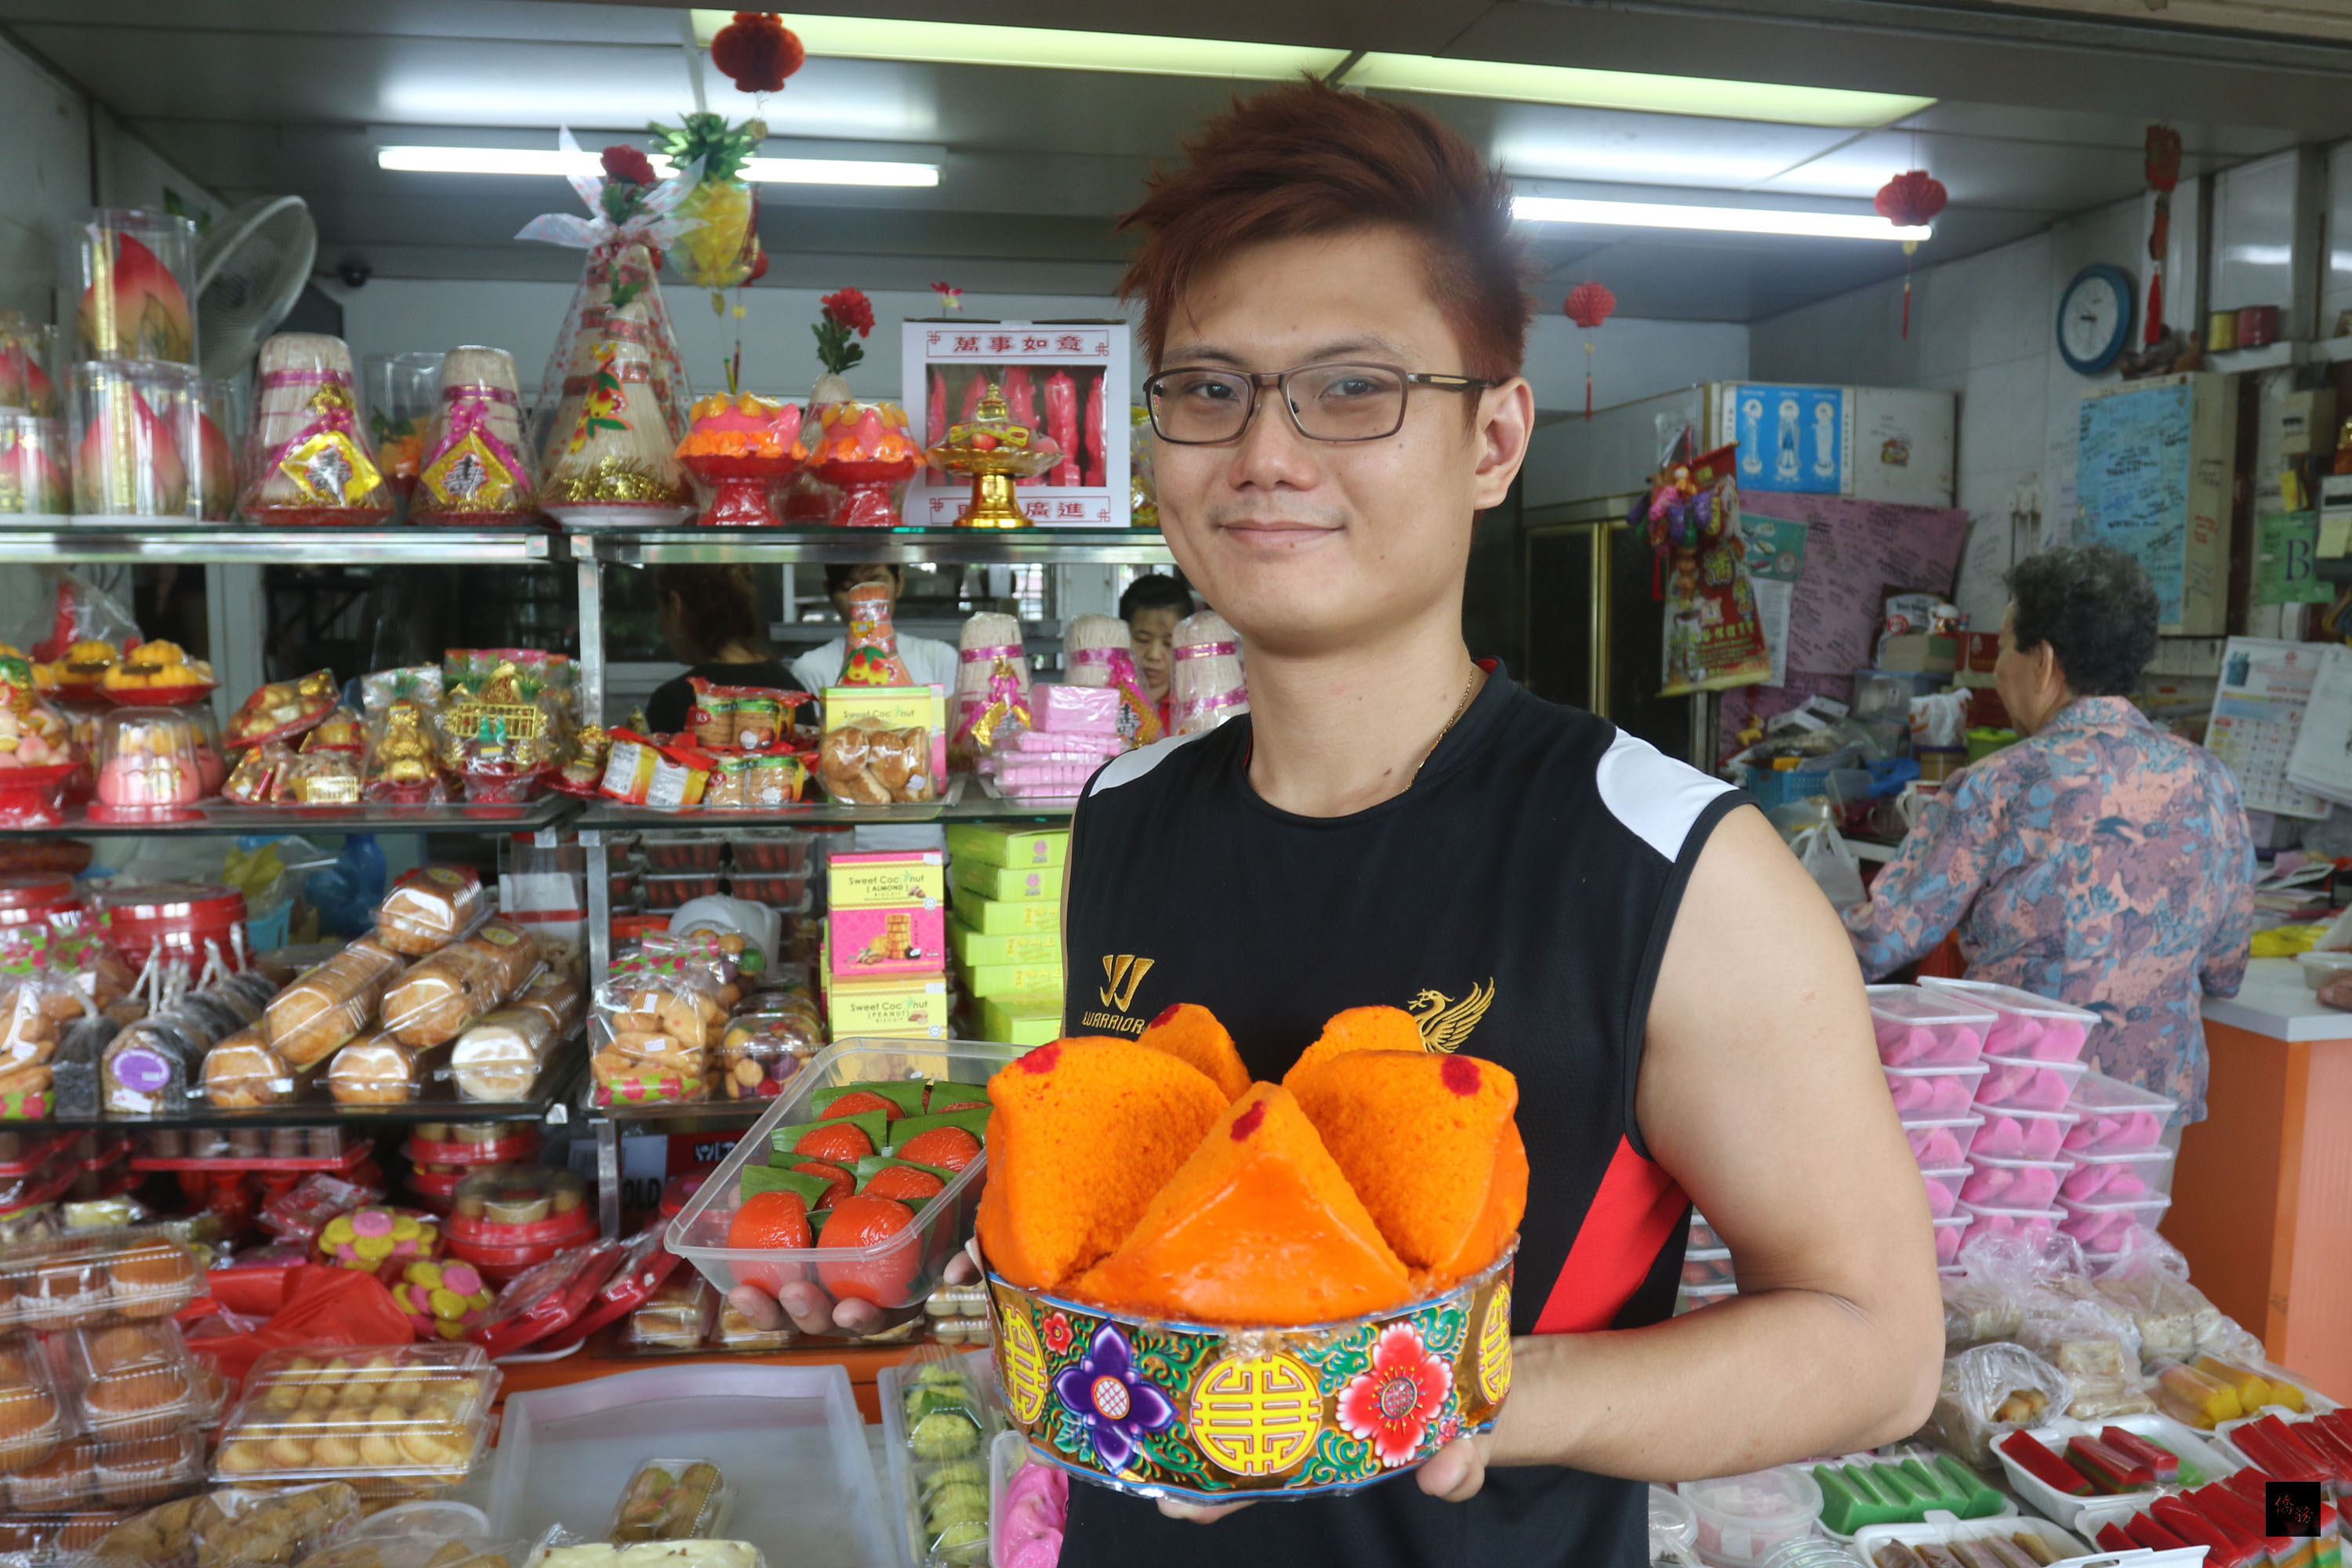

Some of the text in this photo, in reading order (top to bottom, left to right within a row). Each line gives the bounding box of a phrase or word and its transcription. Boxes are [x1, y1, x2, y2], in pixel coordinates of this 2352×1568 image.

[954, 335, 1082, 352] 萬事如意
[849, 876, 877, 885] Sweet
[851, 1003, 879, 1011] Sweet
[1082, 1011, 1145, 1034] WARRIOR
